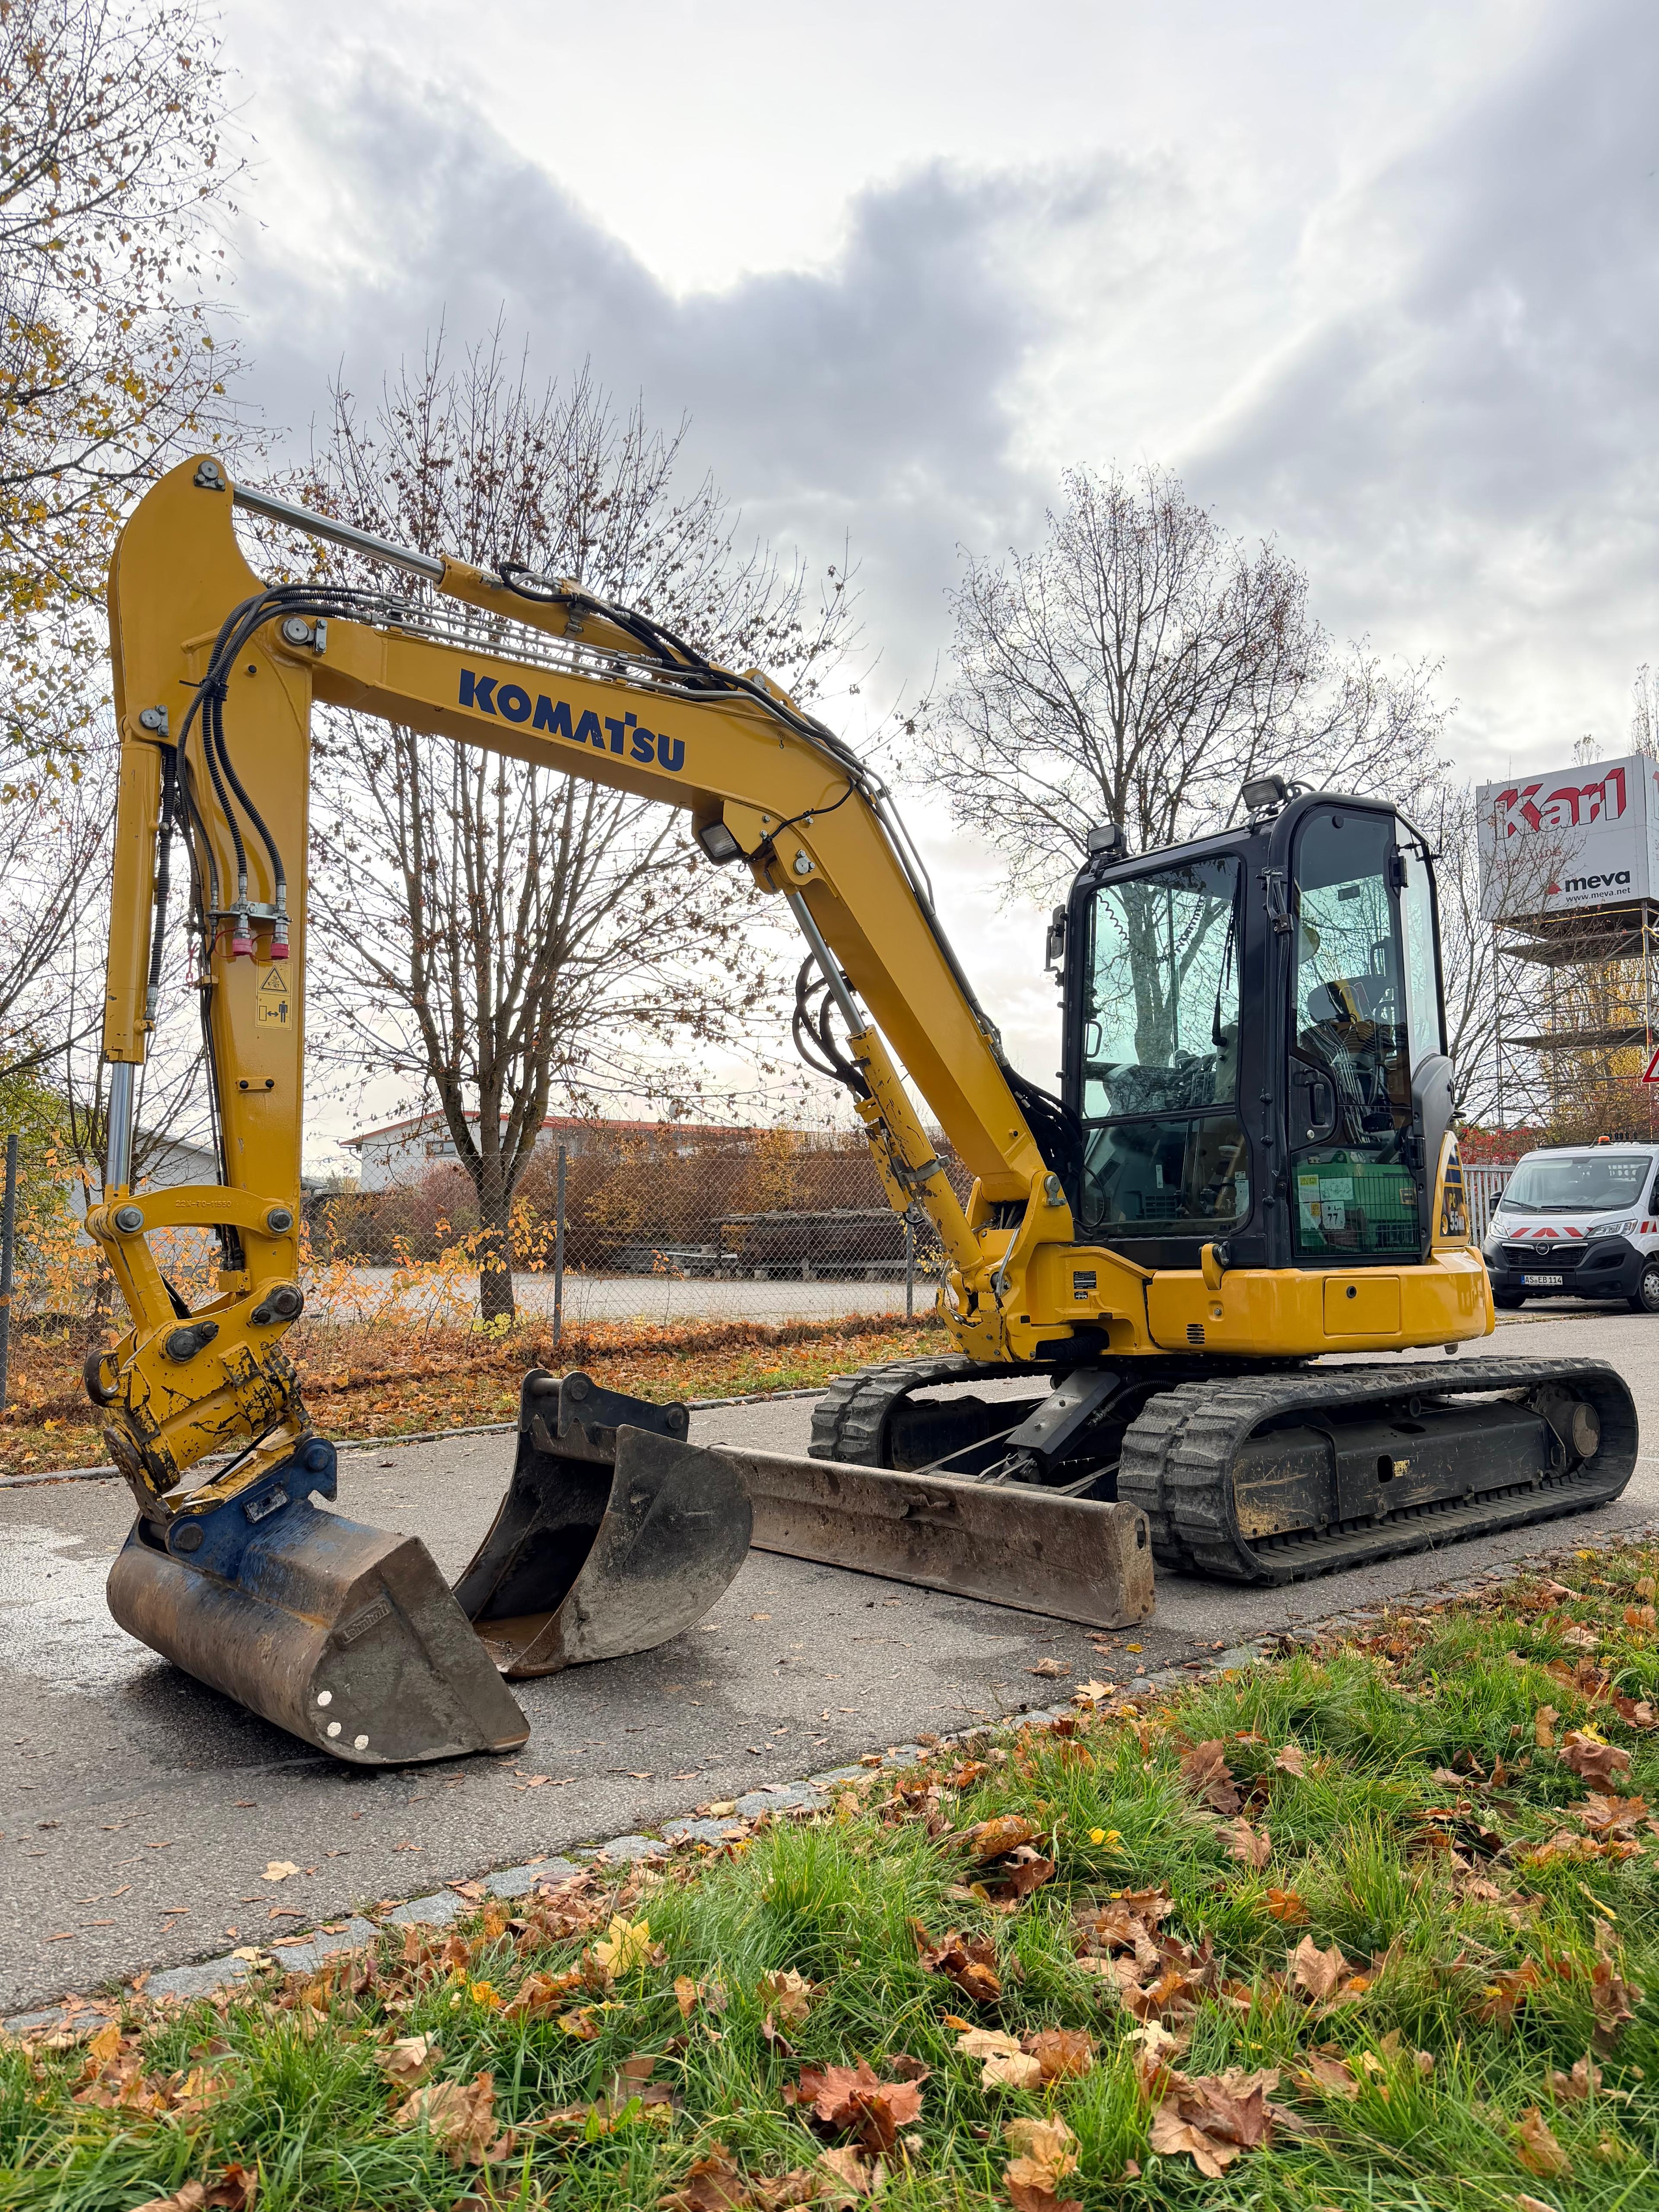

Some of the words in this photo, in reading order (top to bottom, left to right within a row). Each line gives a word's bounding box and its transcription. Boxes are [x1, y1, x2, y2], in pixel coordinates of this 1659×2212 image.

[458, 668, 685, 772] KOMATSU
[1494, 767, 1626, 840] Karl
[1565, 871, 1630, 892] meva
[1566, 887, 1630, 902] www.meva.net
[1449, 1193, 1456, 1208] PC
[1327, 1213, 1338, 1224] 77
